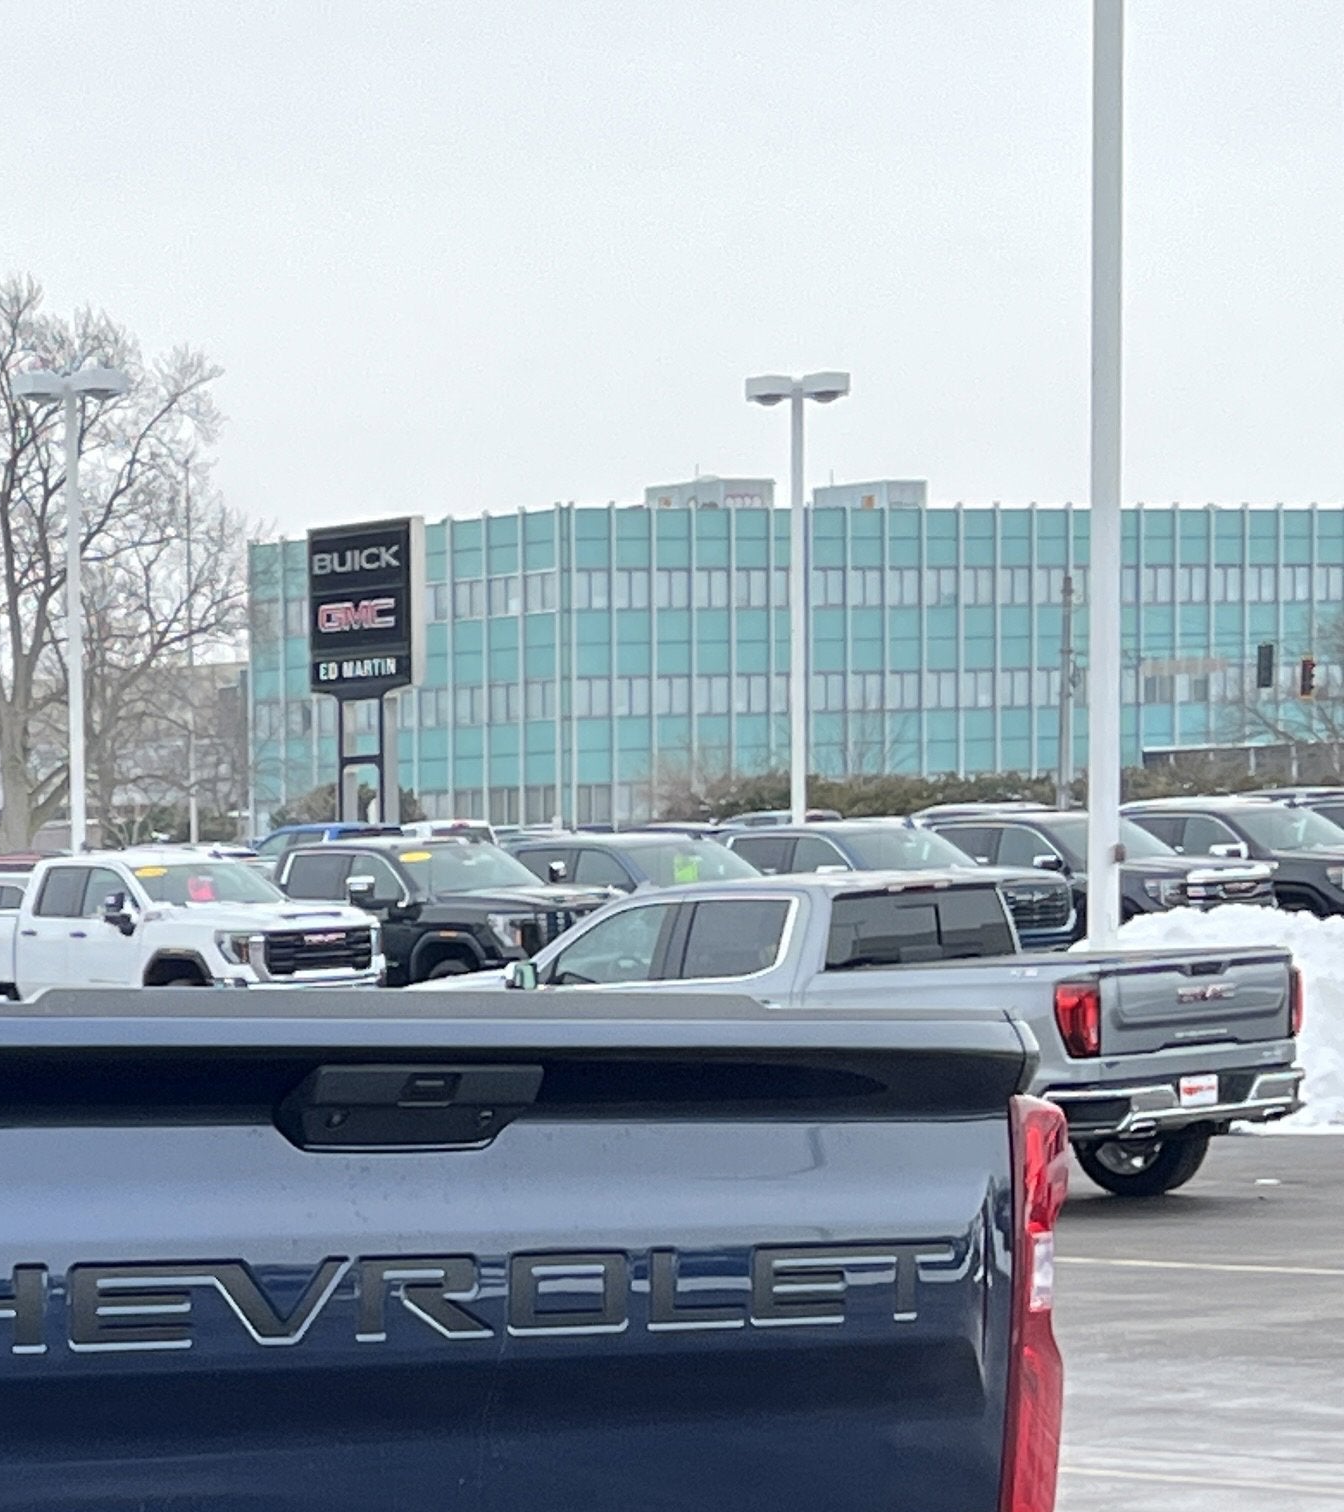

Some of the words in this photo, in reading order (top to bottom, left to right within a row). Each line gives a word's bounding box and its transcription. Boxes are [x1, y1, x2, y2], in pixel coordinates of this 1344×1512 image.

[312, 544, 401, 575] BUICK
[318, 598, 396, 633] GMC
[319, 661, 338, 680] ED
[342, 657, 397, 679] MARTIN
